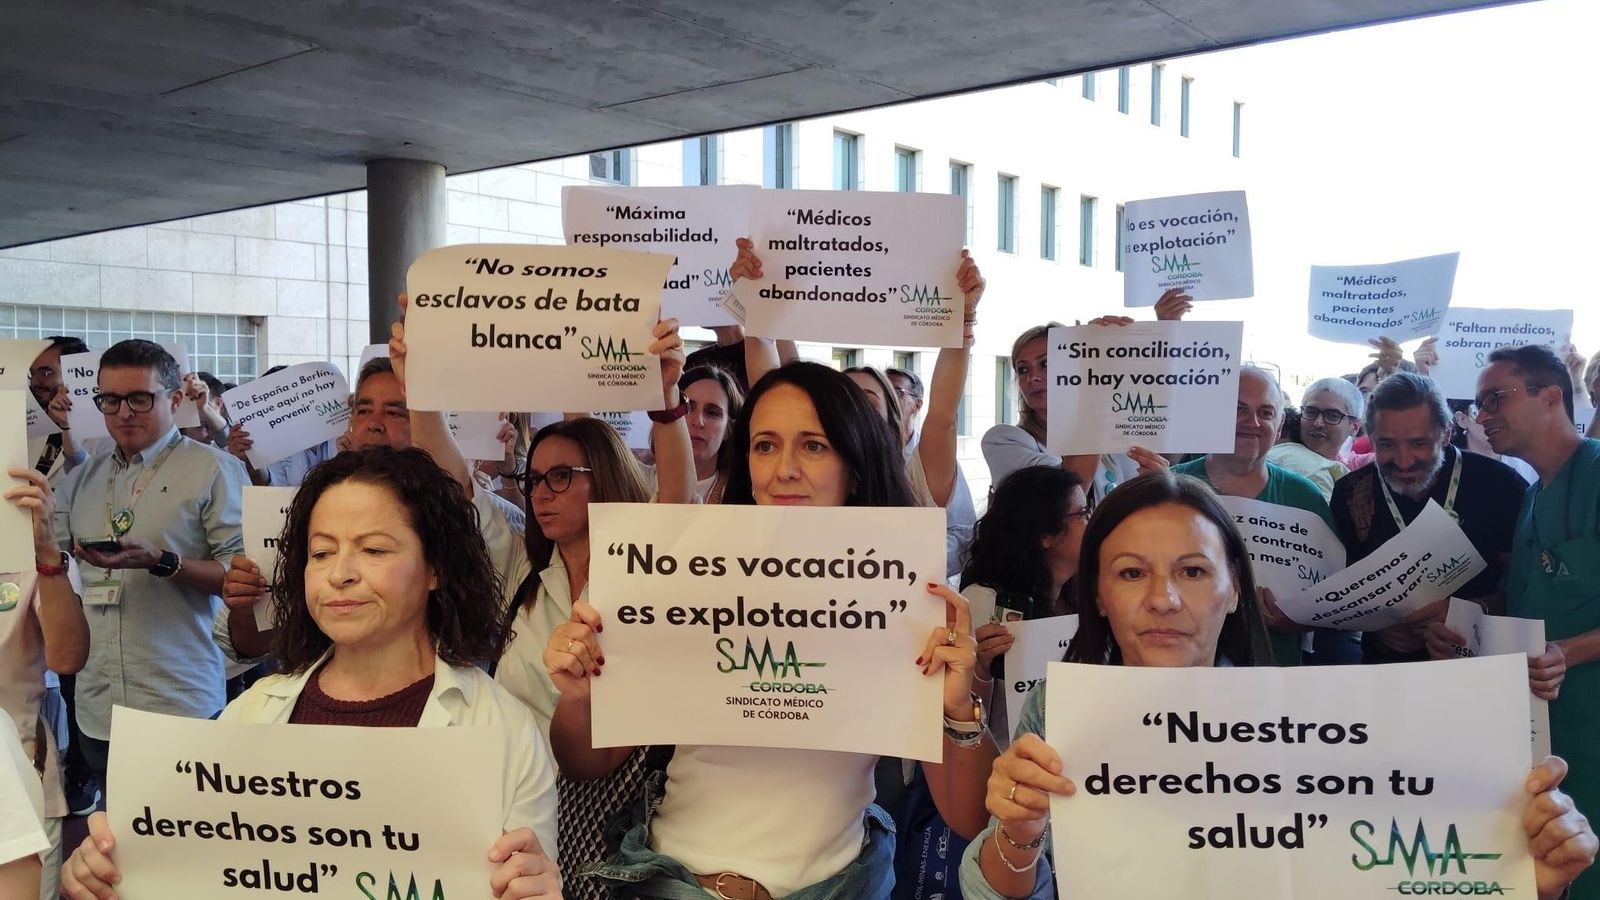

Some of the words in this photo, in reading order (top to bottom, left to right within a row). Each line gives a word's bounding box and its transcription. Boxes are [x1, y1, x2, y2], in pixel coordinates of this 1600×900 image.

[606, 206, 686, 220] “Máxima
[787, 209, 872, 227] “Médicos
[1139, 220, 1155, 230] es
[1160, 208, 1238, 228] vocación,
[574, 229, 718, 246] responsabilidad,
[768, 234, 889, 255] maltratados,
[1133, 229, 1235, 255] explotación”
[465, 258, 514, 276] “No
[522, 264, 608, 279] somos
[785, 261, 872, 280] pacientes
[1152, 252, 1201, 273] SMA
[704, 269, 734, 288] SM
[1336, 275, 1397, 286] “Médicos
[415, 286, 526, 310] esclavos
[534, 288, 568, 311] de
[576, 289, 640, 312] bata
[759, 284, 897, 304] abandonados”
[901, 283, 952, 306] SMA
[1322, 287, 1407, 300] maltratados,
[1332, 304, 1394, 315] pacientes
[1314, 314, 1410, 328] abandonados”
[1449, 322, 1496, 333] “Faltan
[1500, 323, 1555, 336] médicos,
[471, 324, 577, 350] blanca”
[1446, 338, 1491, 348] sobran
[581, 336, 644, 362] SMA
[1058, 342, 1100, 359] “Sin
[1106, 341, 1230, 361] conciliación,
[67, 366, 93, 378] “No
[1056, 375, 1081, 386] no
[1088, 368, 1124, 390] hay
[1130, 366, 1231, 386] vocación”
[74, 388, 88, 396] es
[232, 400, 250, 410] “De
[252, 386, 289, 403] España
[299, 370, 334, 384] Berlín,
[239, 405, 274, 426] porque
[277, 393, 299, 408] aquí
[302, 389, 314, 398] no
[315, 380, 335, 392] hay
[1112, 391, 1168, 414] SMA
[268, 400, 315, 429] porvenir”
[1248, 516, 1285, 530] años
[1290, 523, 1308, 536] de
[1252, 535, 1324, 559] contratos
[608, 543, 677, 575] “No
[689, 555, 726, 576] es
[737, 548, 916, 586] vocación,
[1260, 553, 1300, 566] mes”
[1426, 553, 1467, 583] SMA
[1312, 580, 1392, 622] descansar
[1396, 551, 1433, 586] para
[1315, 551, 1408, 603] “Queremos
[1331, 604, 1381, 626] poder
[1385, 567, 1429, 608] curar”
[617, 604, 654, 625] es
[666, 596, 906, 634] explotación”
[716, 634, 826, 679] SMA
[750, 682, 827, 695] CORDOBA
[726, 696, 780, 707] SINDICATO
[783, 696, 824, 708] MÉDICO
[743, 710, 755, 719] DE
[758, 709, 809, 720] CÓRDOBA
[1141, 711, 1368, 745] “Nuestros
[176, 760, 362, 800] “Nuestros
[1084, 762, 1281, 796] derechos
[1296, 774, 1374, 796] son
[1389, 770, 1434, 796] tu
[132, 806, 297, 844] derechos
[308, 827, 371, 848] son
[382, 823, 420, 851] tu
[1188, 812, 1328, 850] salud”
[1350, 816, 1502, 878] SMA
[222, 859, 338, 894] salud”
[1396, 880, 1504, 896] CORDOBA
